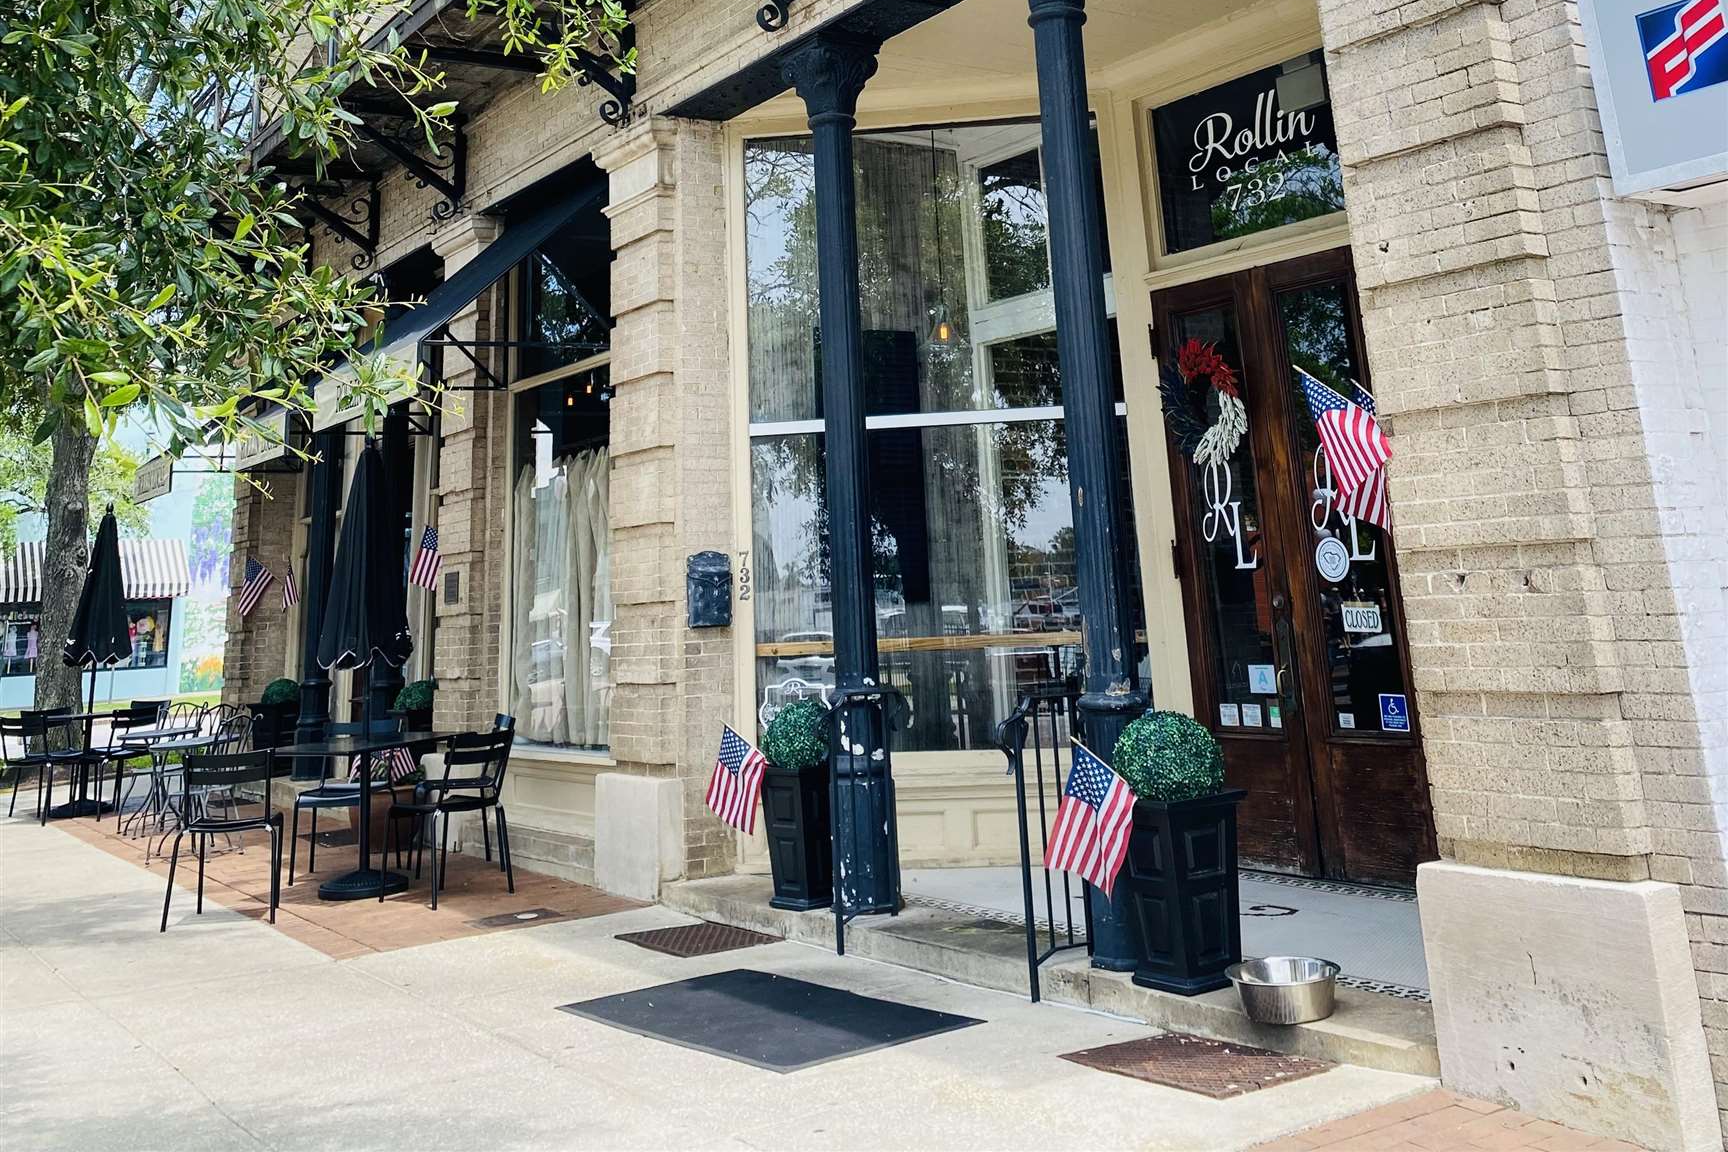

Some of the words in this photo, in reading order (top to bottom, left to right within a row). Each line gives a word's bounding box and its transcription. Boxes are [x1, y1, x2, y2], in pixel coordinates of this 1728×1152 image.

[1189, 89, 1315, 173] Rollin
[1191, 140, 1319, 191] LOCAL
[1226, 173, 1286, 211] 732
[738, 550, 751, 600] 732
[1345, 609, 1379, 628] CLOSED
